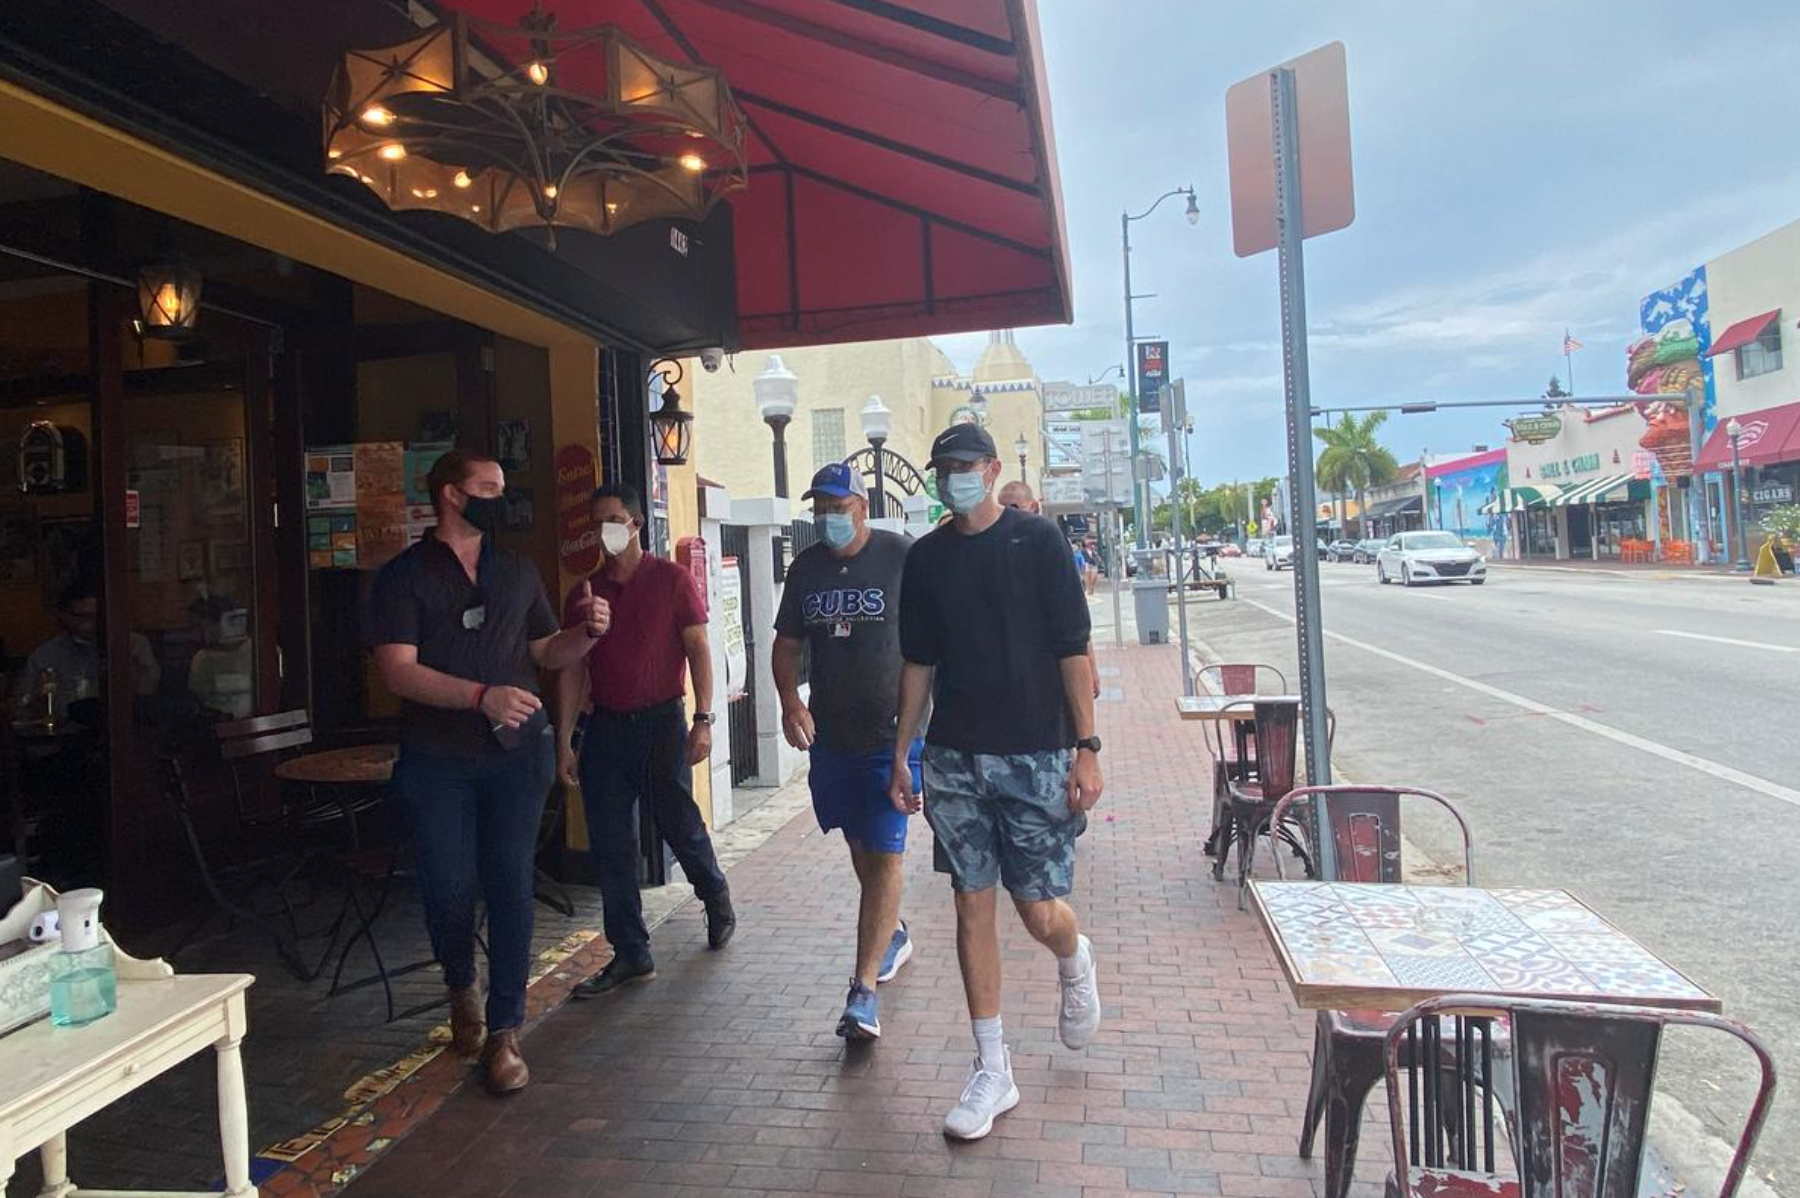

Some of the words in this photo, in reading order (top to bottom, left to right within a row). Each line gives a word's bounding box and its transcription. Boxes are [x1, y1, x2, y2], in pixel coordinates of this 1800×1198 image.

[1045, 387, 1116, 409] TOWER
[1753, 487, 1792, 501] CIGARS
[803, 588, 885, 618] CUBS
